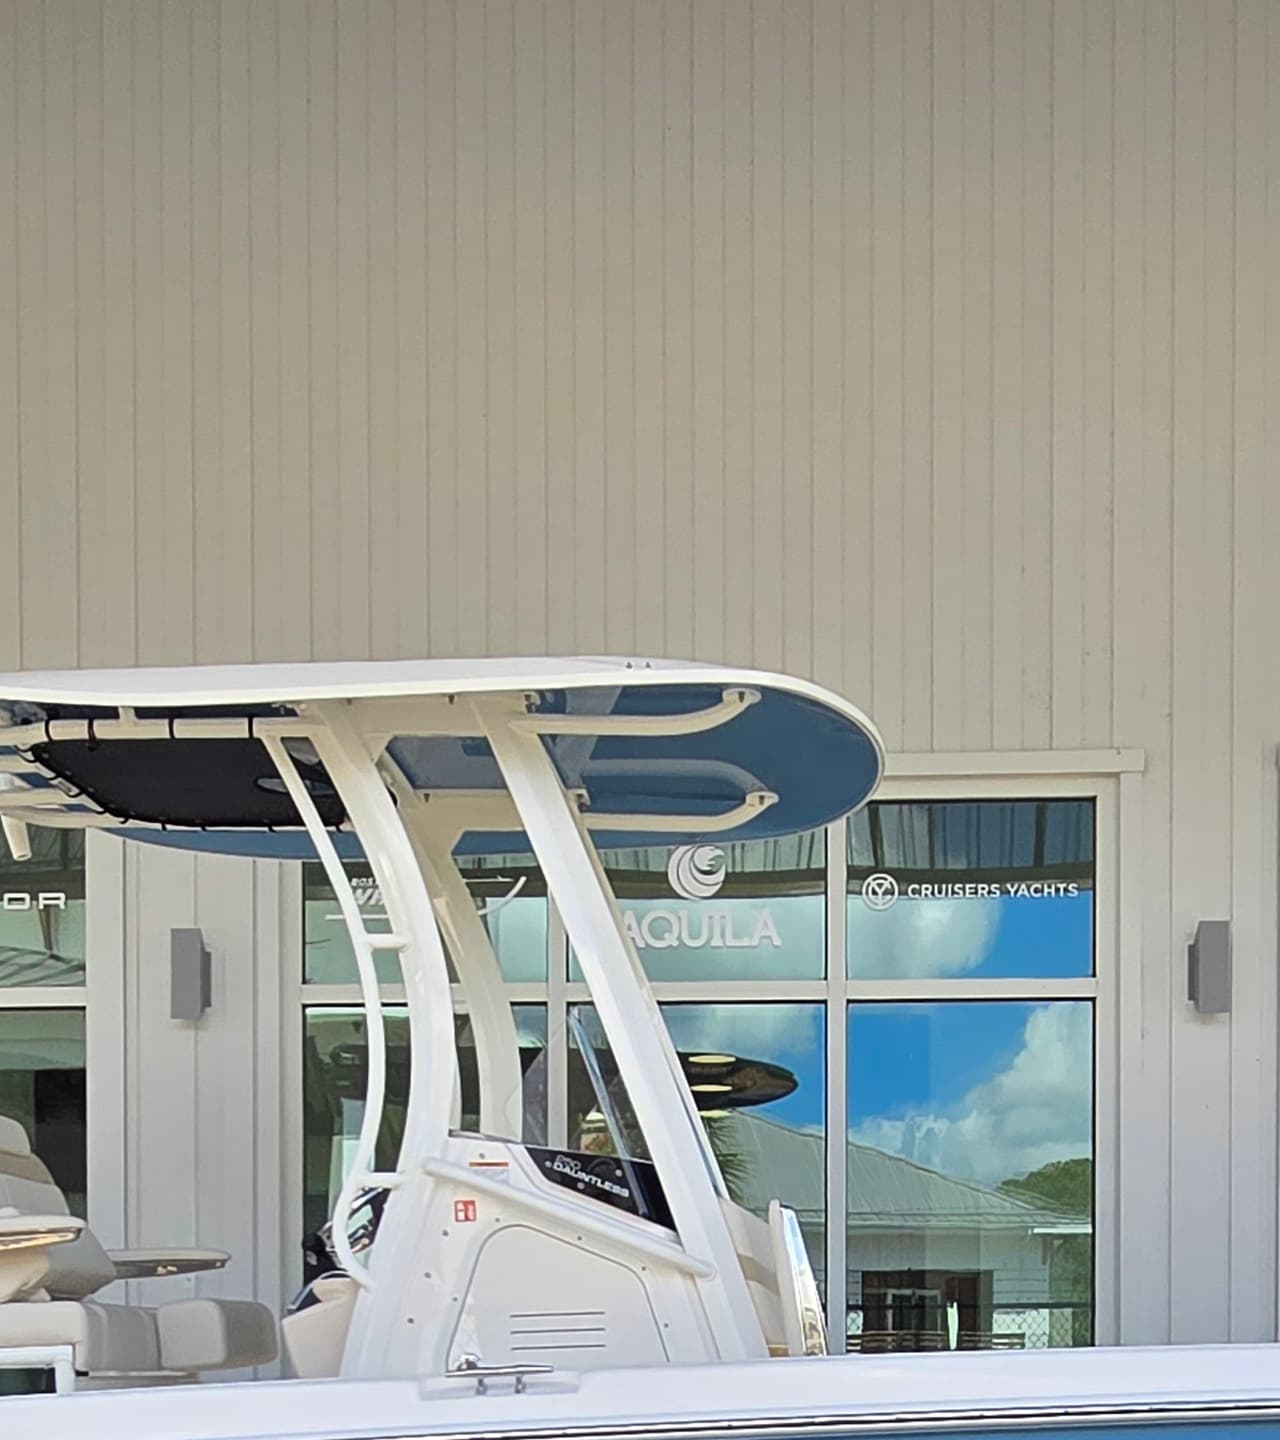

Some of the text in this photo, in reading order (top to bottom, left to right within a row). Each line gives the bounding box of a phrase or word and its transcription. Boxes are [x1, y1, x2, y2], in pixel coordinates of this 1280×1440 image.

[907, 882, 1079, 898] CRUISERS YACHTS
[622, 909, 782, 948] AQUILA
